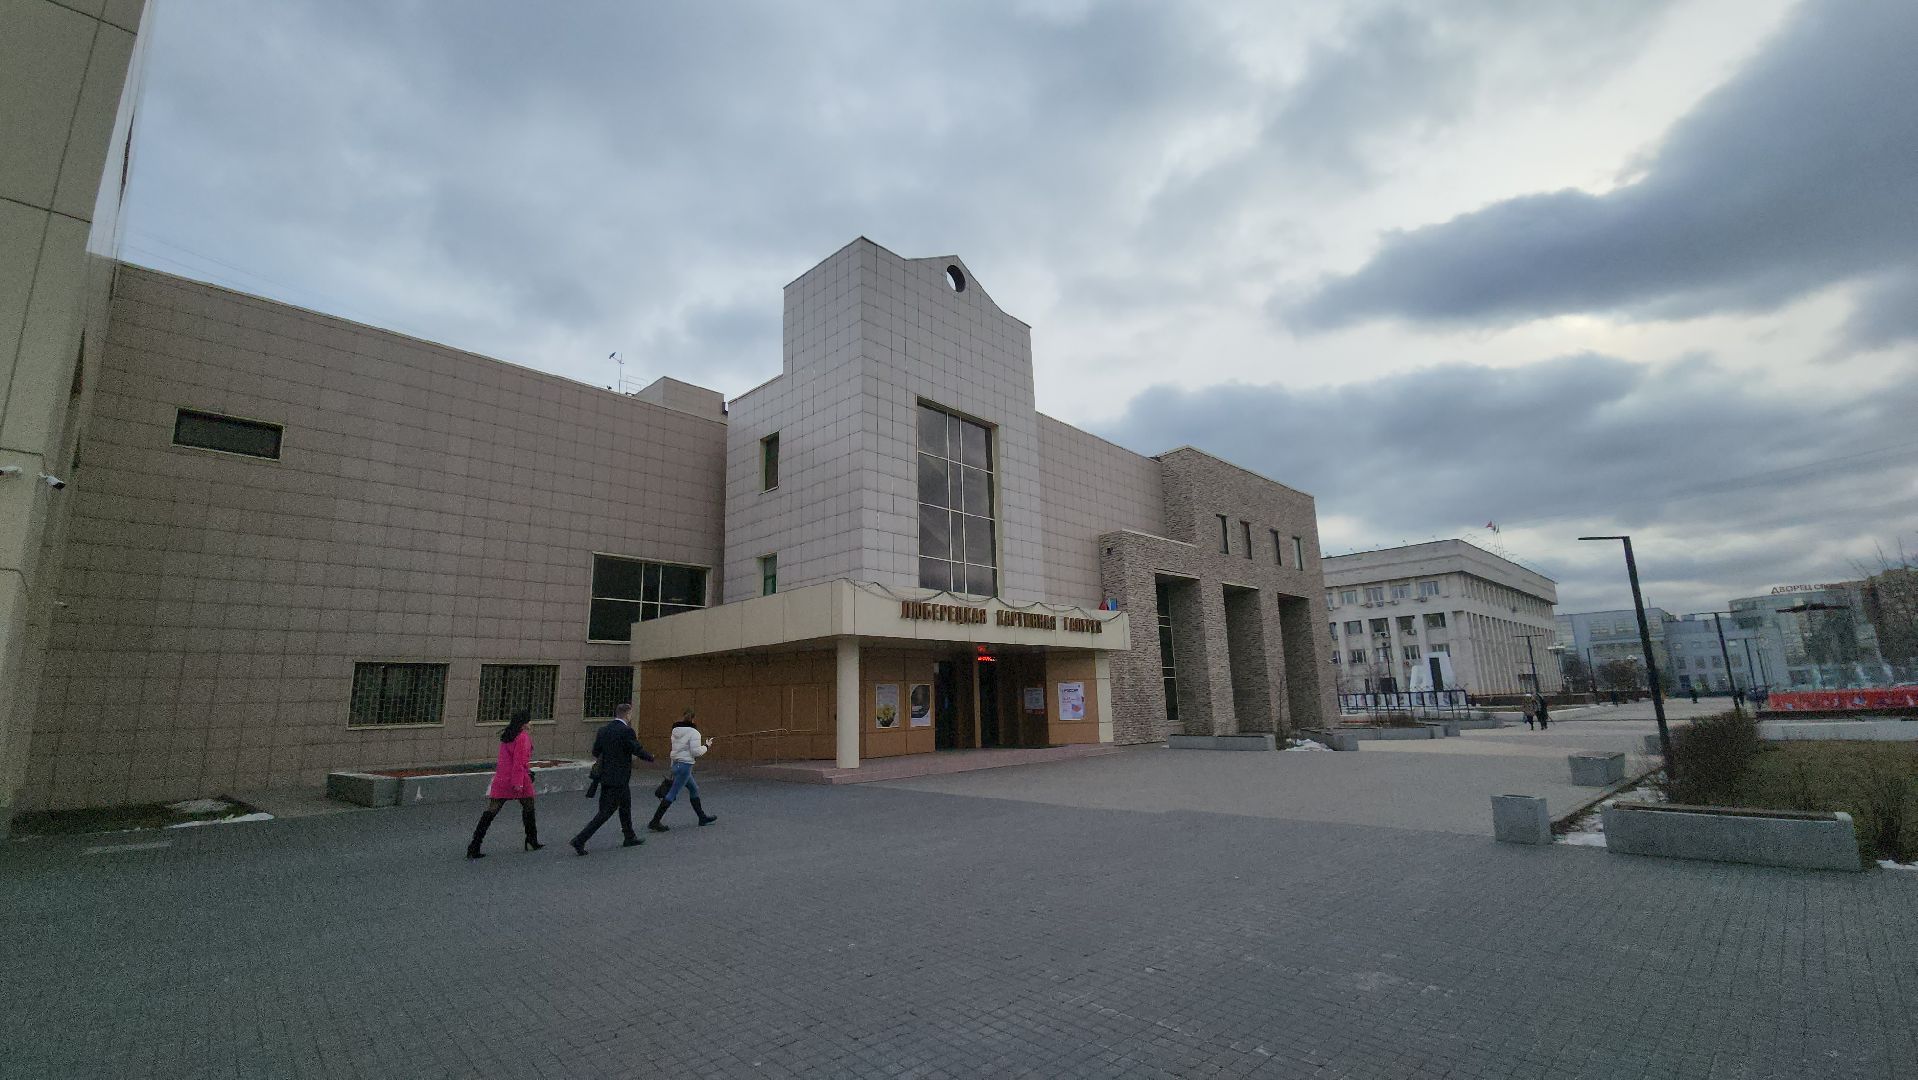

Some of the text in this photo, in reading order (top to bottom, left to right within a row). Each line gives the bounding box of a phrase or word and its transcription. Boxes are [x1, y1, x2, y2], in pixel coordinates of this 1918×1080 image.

[1771, 585, 1812, 595] ДВОРЕЦ
[901, 600, 987, 625] ЛЮБЕРЕЦКАЯ
[996, 609, 1057, 630] КАРТИННАЯ
